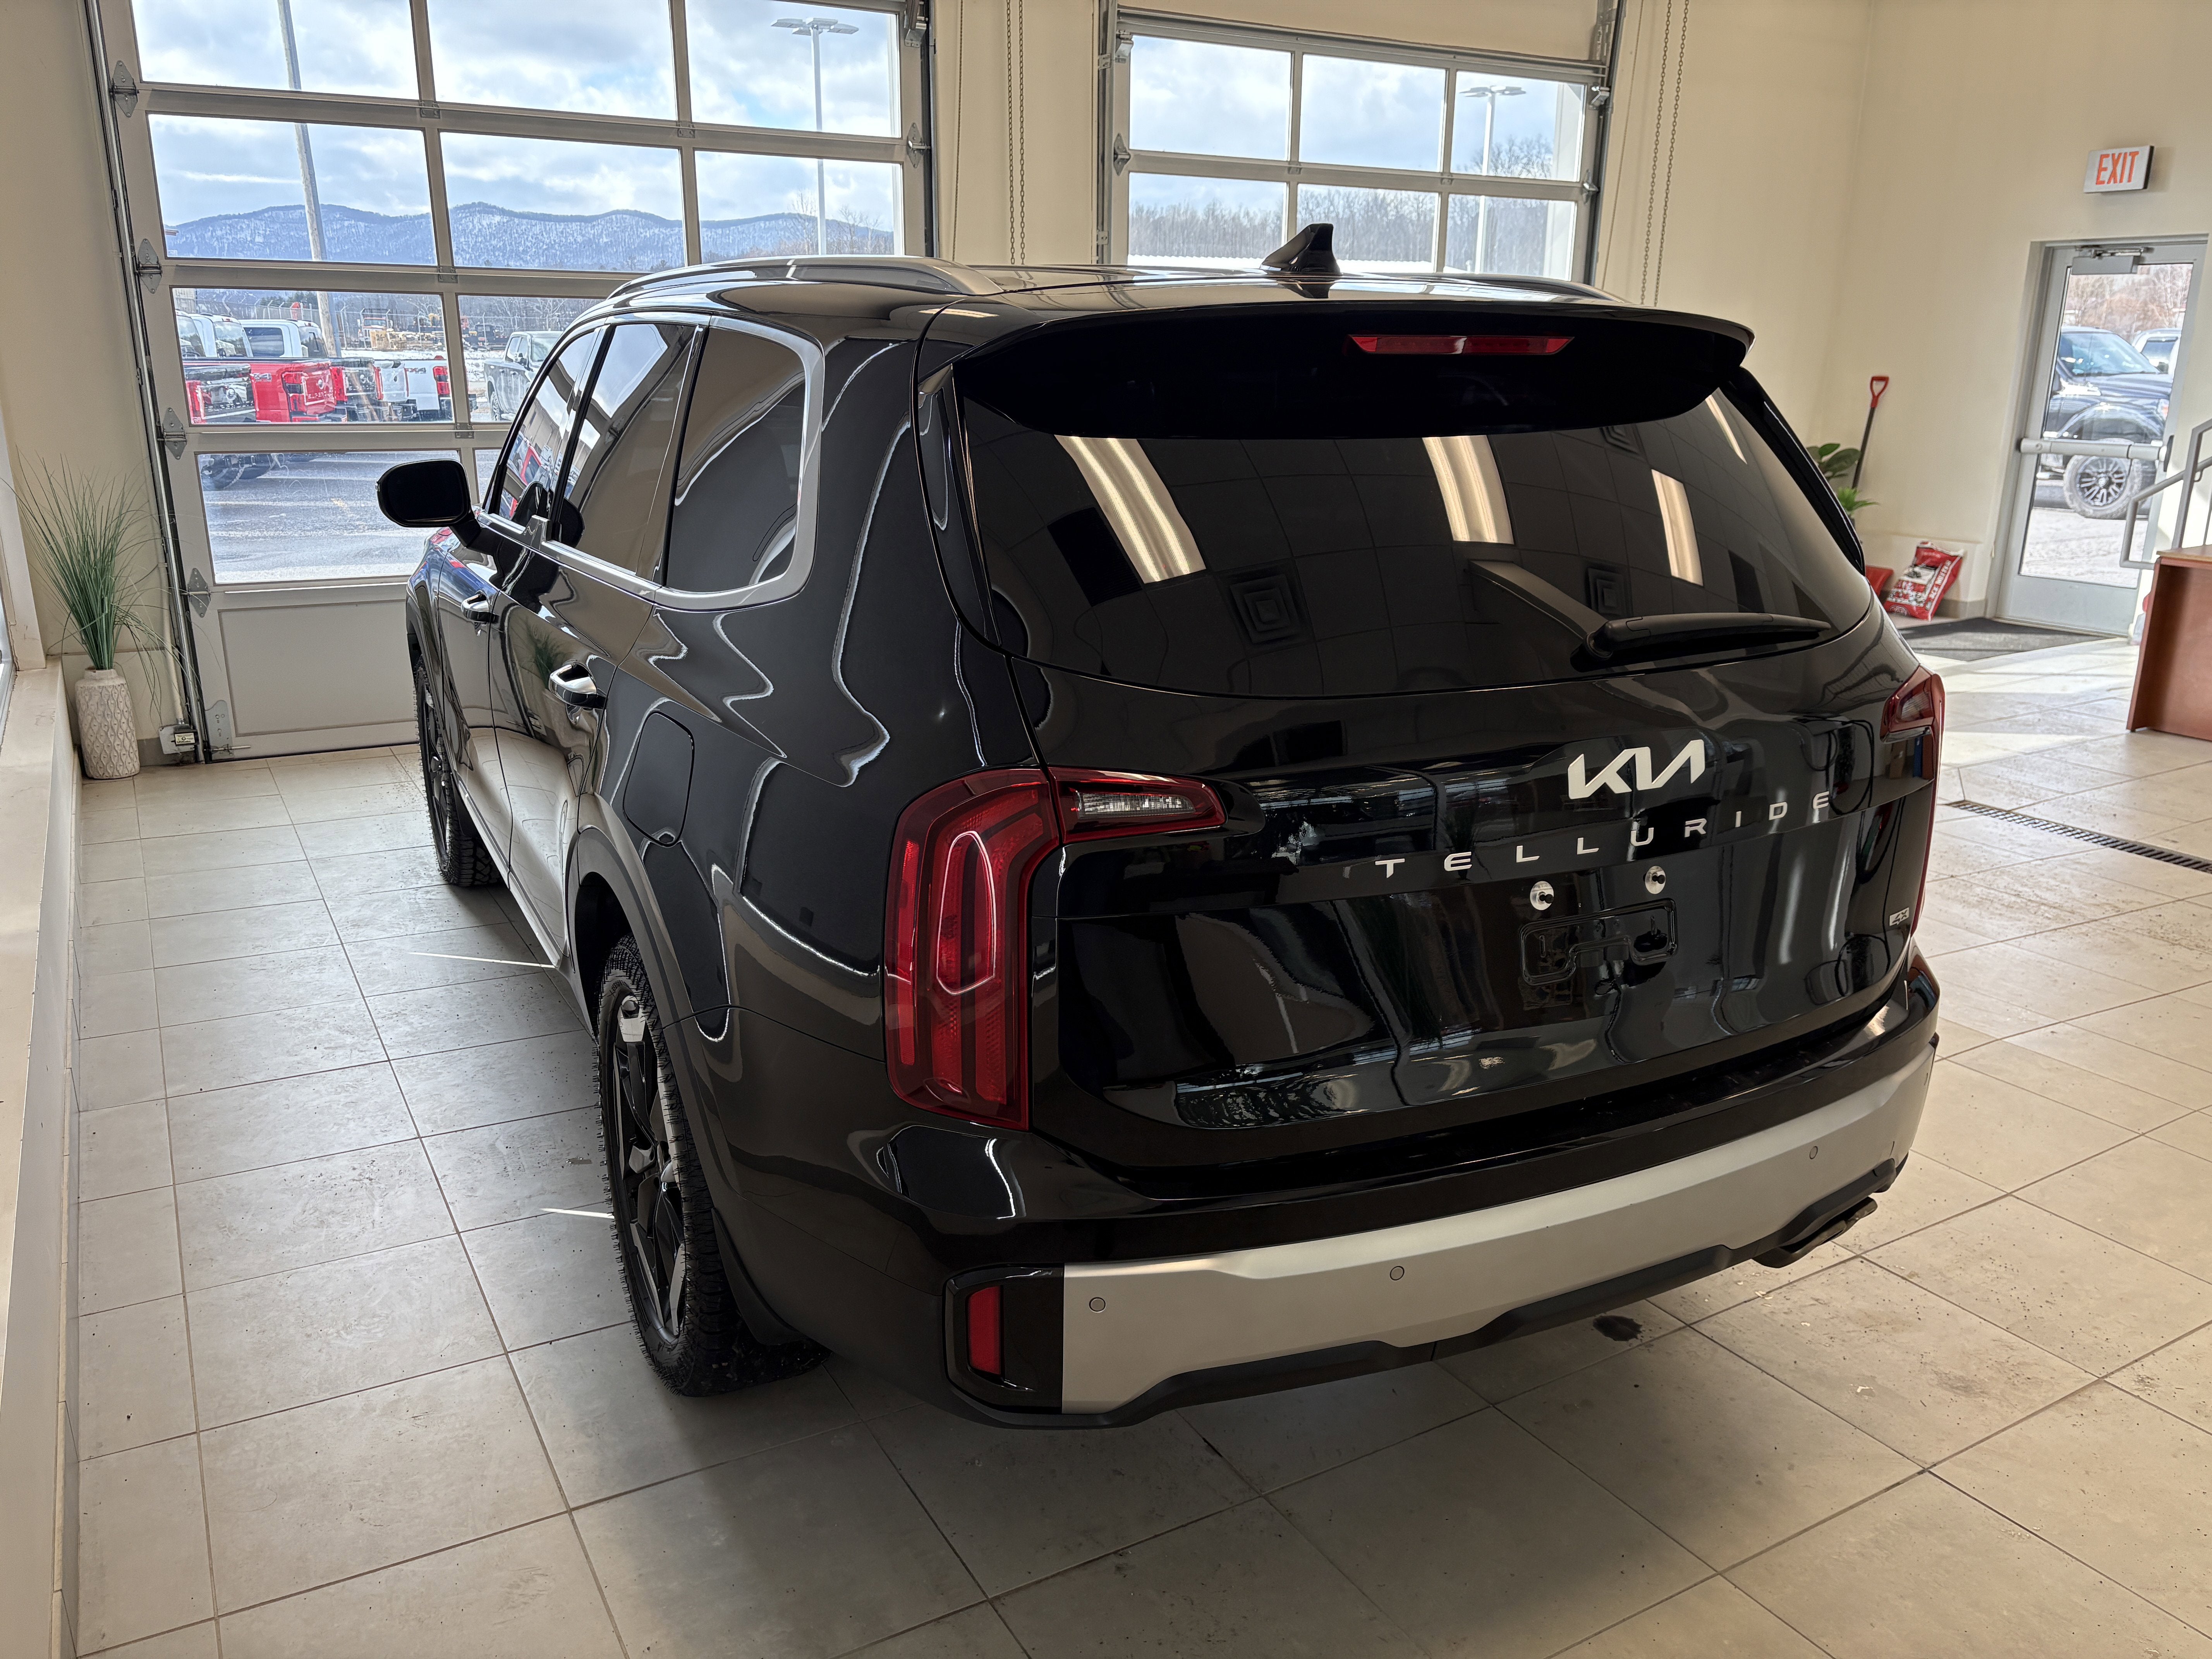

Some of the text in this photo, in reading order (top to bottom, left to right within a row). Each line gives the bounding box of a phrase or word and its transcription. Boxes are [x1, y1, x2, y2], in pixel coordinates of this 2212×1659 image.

[2095, 151, 2140, 185] EXIT
[1567, 739, 1705, 799] KIA
[1375, 791, 1830, 878] TELLURIDE
